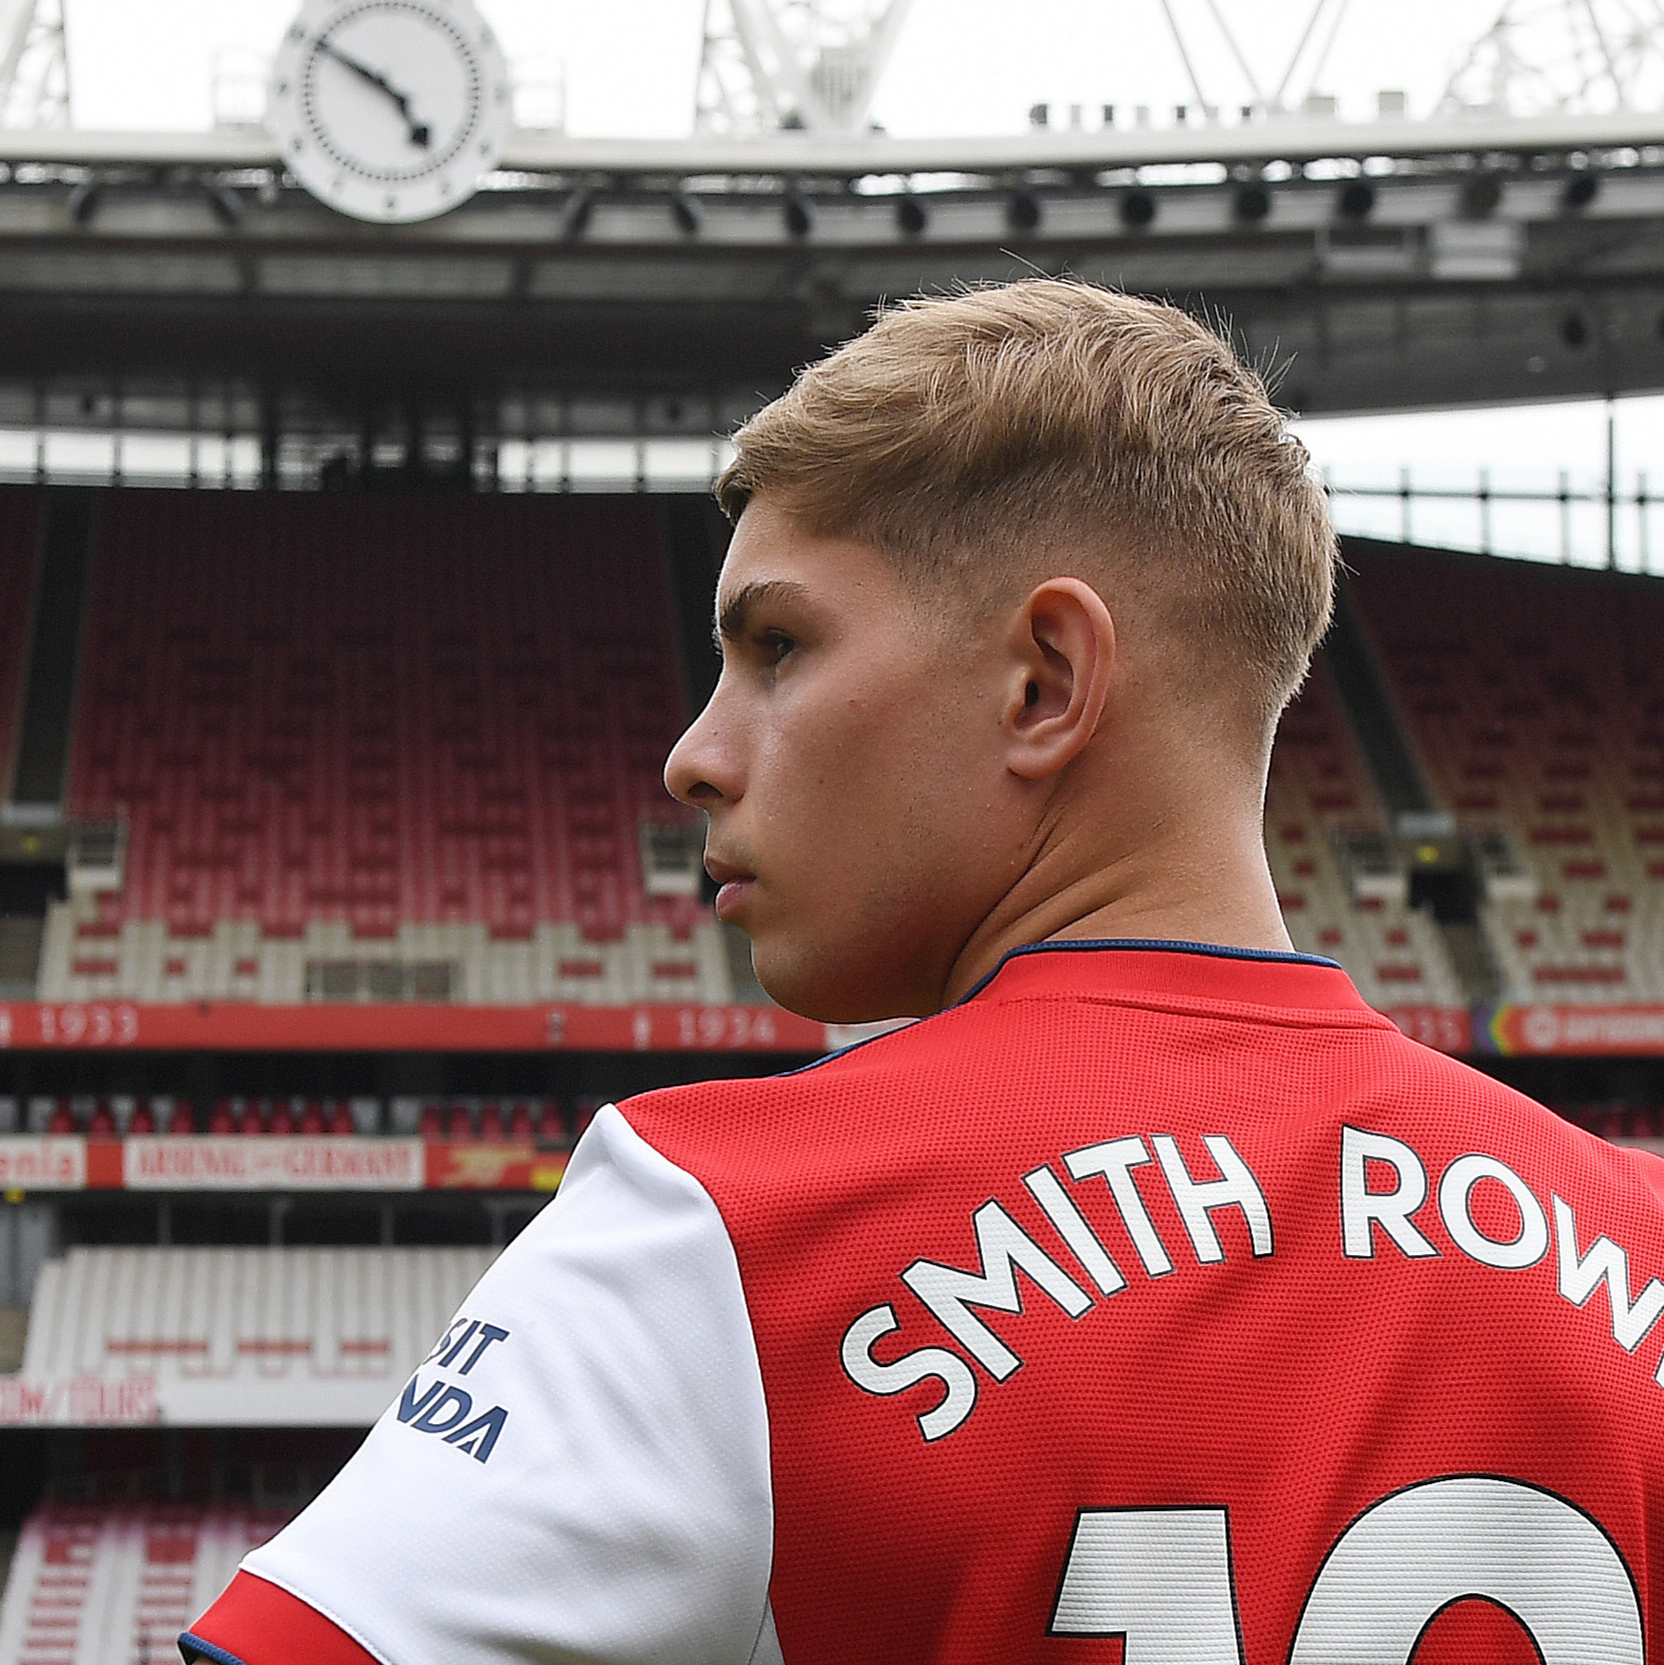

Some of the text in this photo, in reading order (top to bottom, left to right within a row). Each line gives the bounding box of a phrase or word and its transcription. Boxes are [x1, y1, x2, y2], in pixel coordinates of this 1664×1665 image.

[39, 1003, 137, 1043] 1933
[679, 1010, 776, 1044] 1934
[839, 1133, 1274, 1443] SMITH
